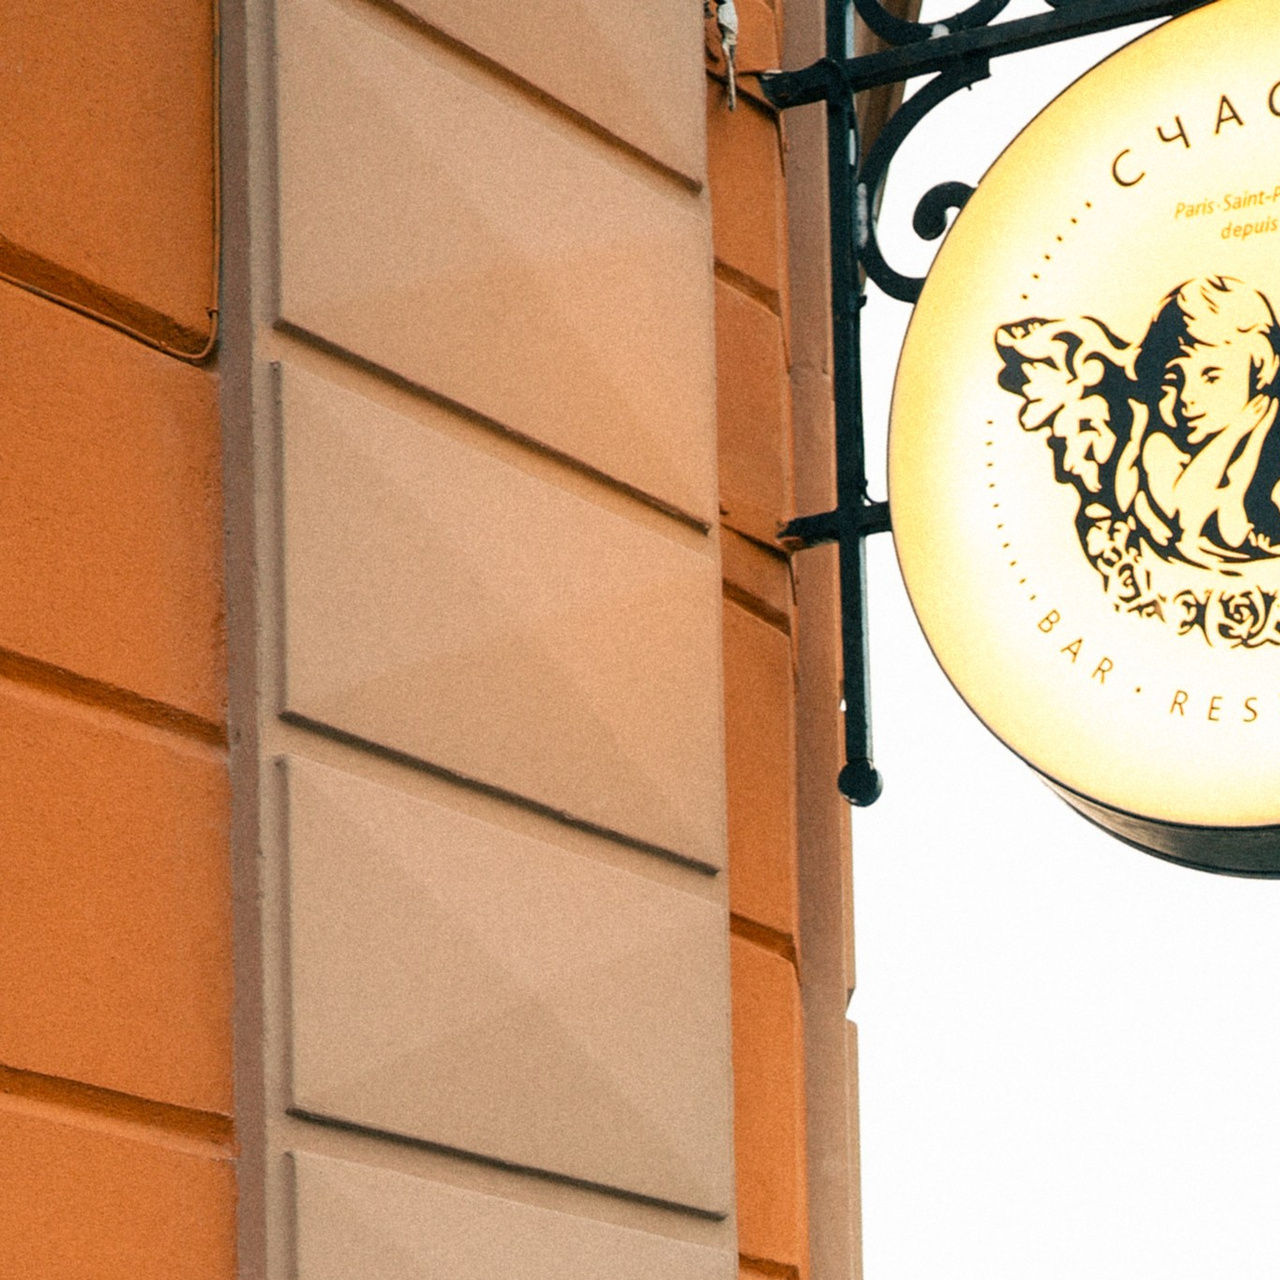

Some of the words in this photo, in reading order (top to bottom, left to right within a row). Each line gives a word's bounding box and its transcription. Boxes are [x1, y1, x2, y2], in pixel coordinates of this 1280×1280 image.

[1174, 197, 1215, 219] Paris
[1220, 215, 1279, 240] depuis
[1037, 608, 1114, 684] BAR
